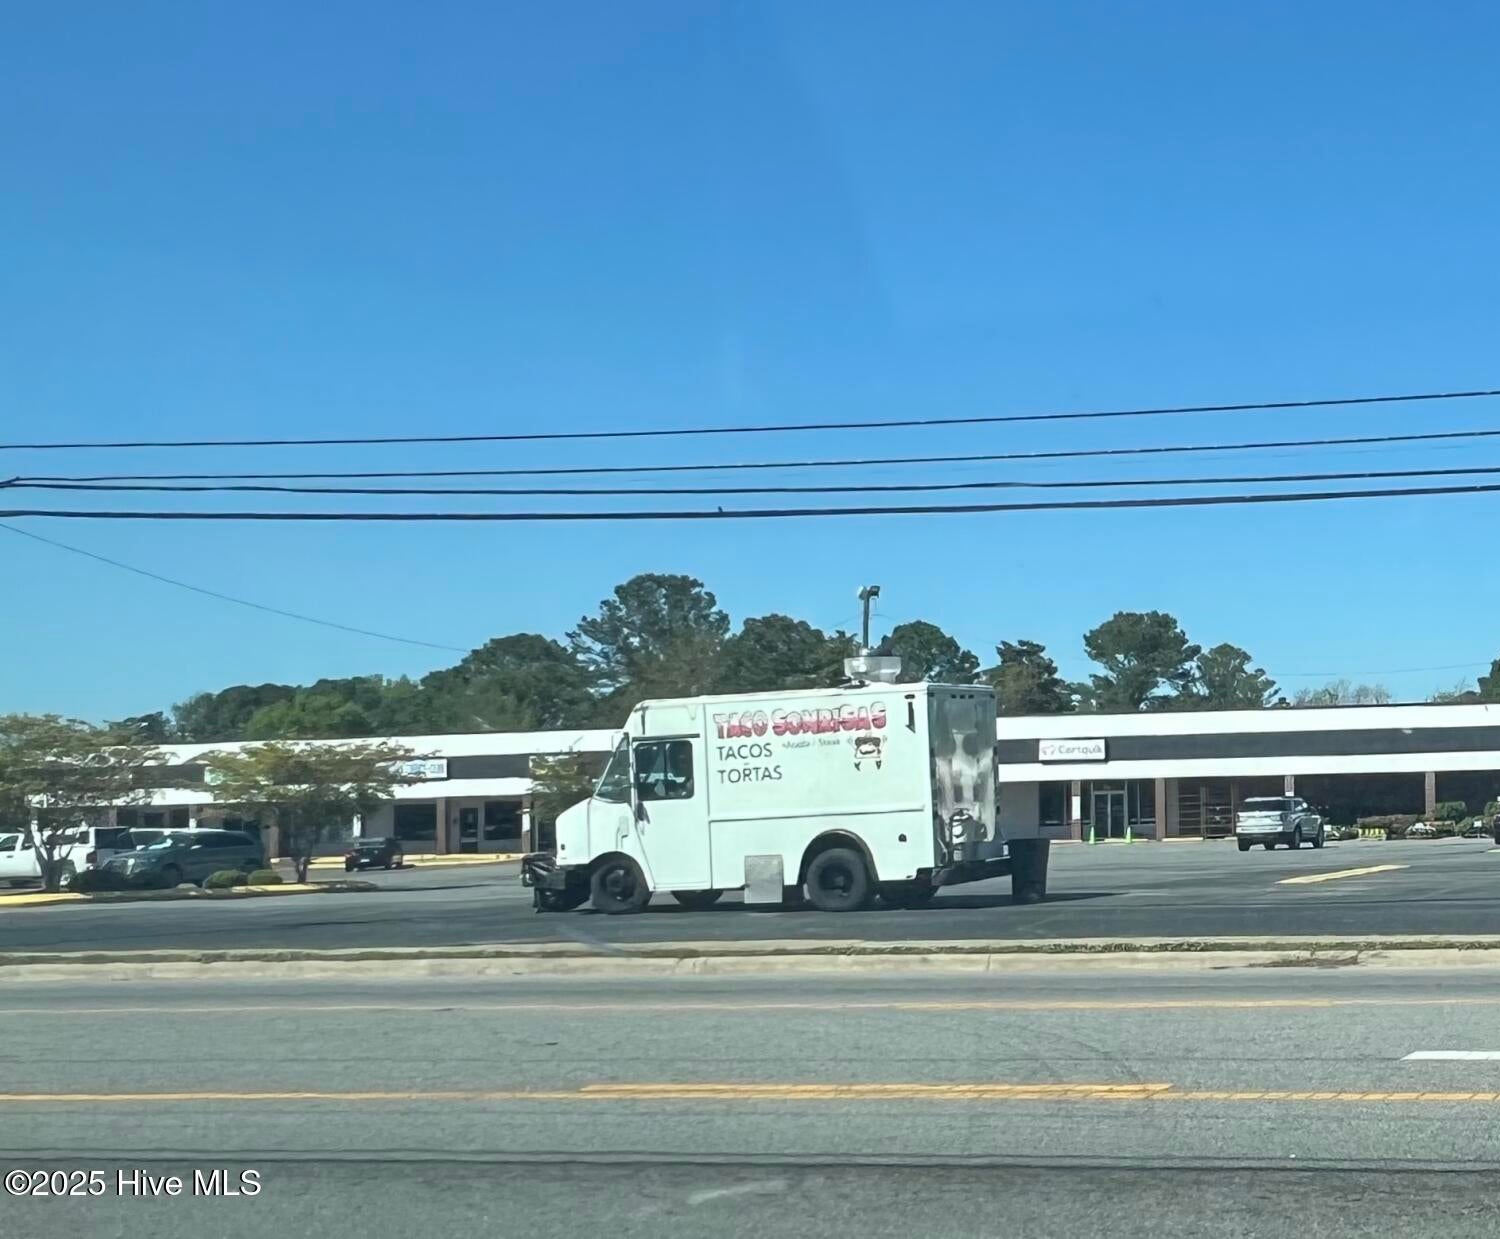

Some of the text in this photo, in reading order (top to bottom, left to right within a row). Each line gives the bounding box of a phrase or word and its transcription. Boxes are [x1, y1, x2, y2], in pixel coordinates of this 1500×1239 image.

[713, 710, 769, 739] TACO
[716, 742, 773, 762] TACOS
[717, 764, 783, 784] TORTAS
